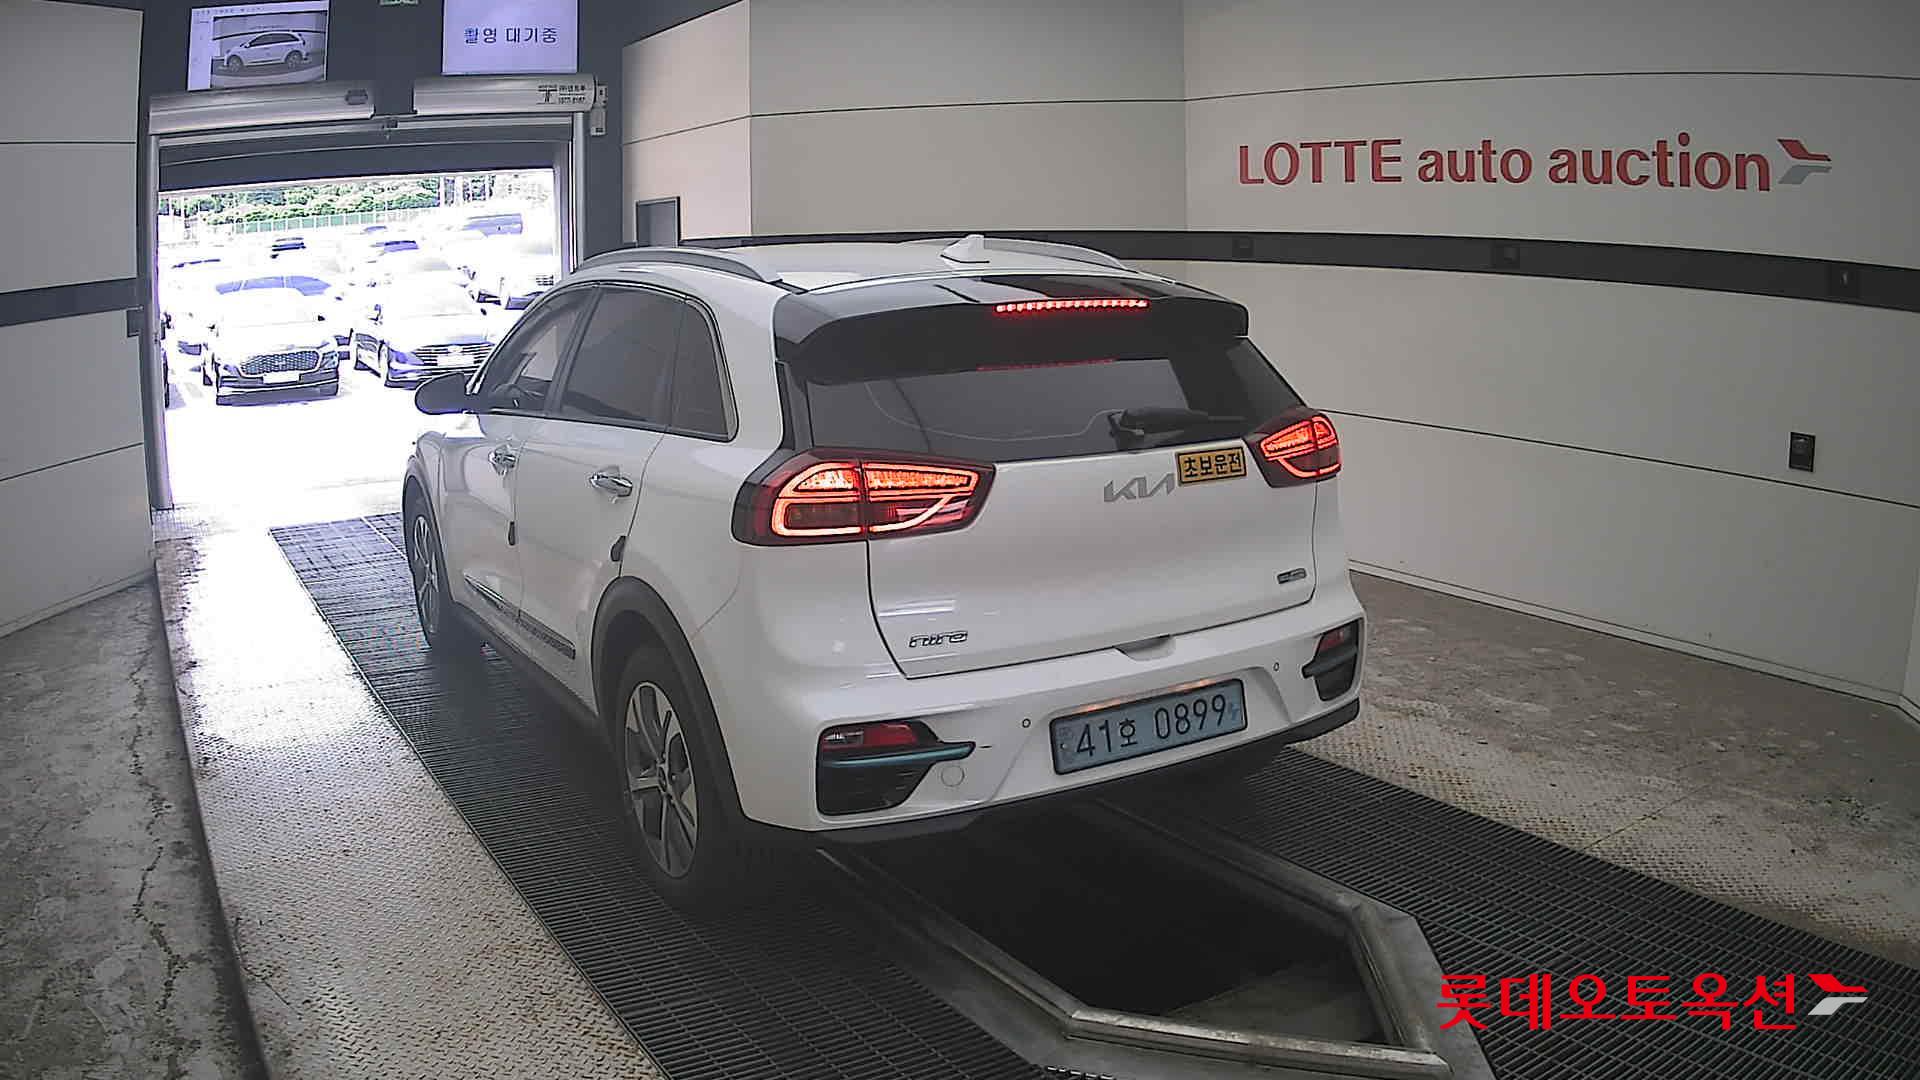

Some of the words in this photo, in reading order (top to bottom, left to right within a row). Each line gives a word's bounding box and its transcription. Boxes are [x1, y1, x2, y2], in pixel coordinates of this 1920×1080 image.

[505, 27, 559, 45] 대기중
[1238, 138, 1402, 186] LOTTE
[1417, 139, 1533, 184] auto
[1548, 131, 1772, 192] auction
[1183, 451, 1243, 479] 초보운전
[1103, 472, 1176, 503] KIA
[1076, 718, 1139, 757] 41호
[1154, 694, 1227, 740] 0899
